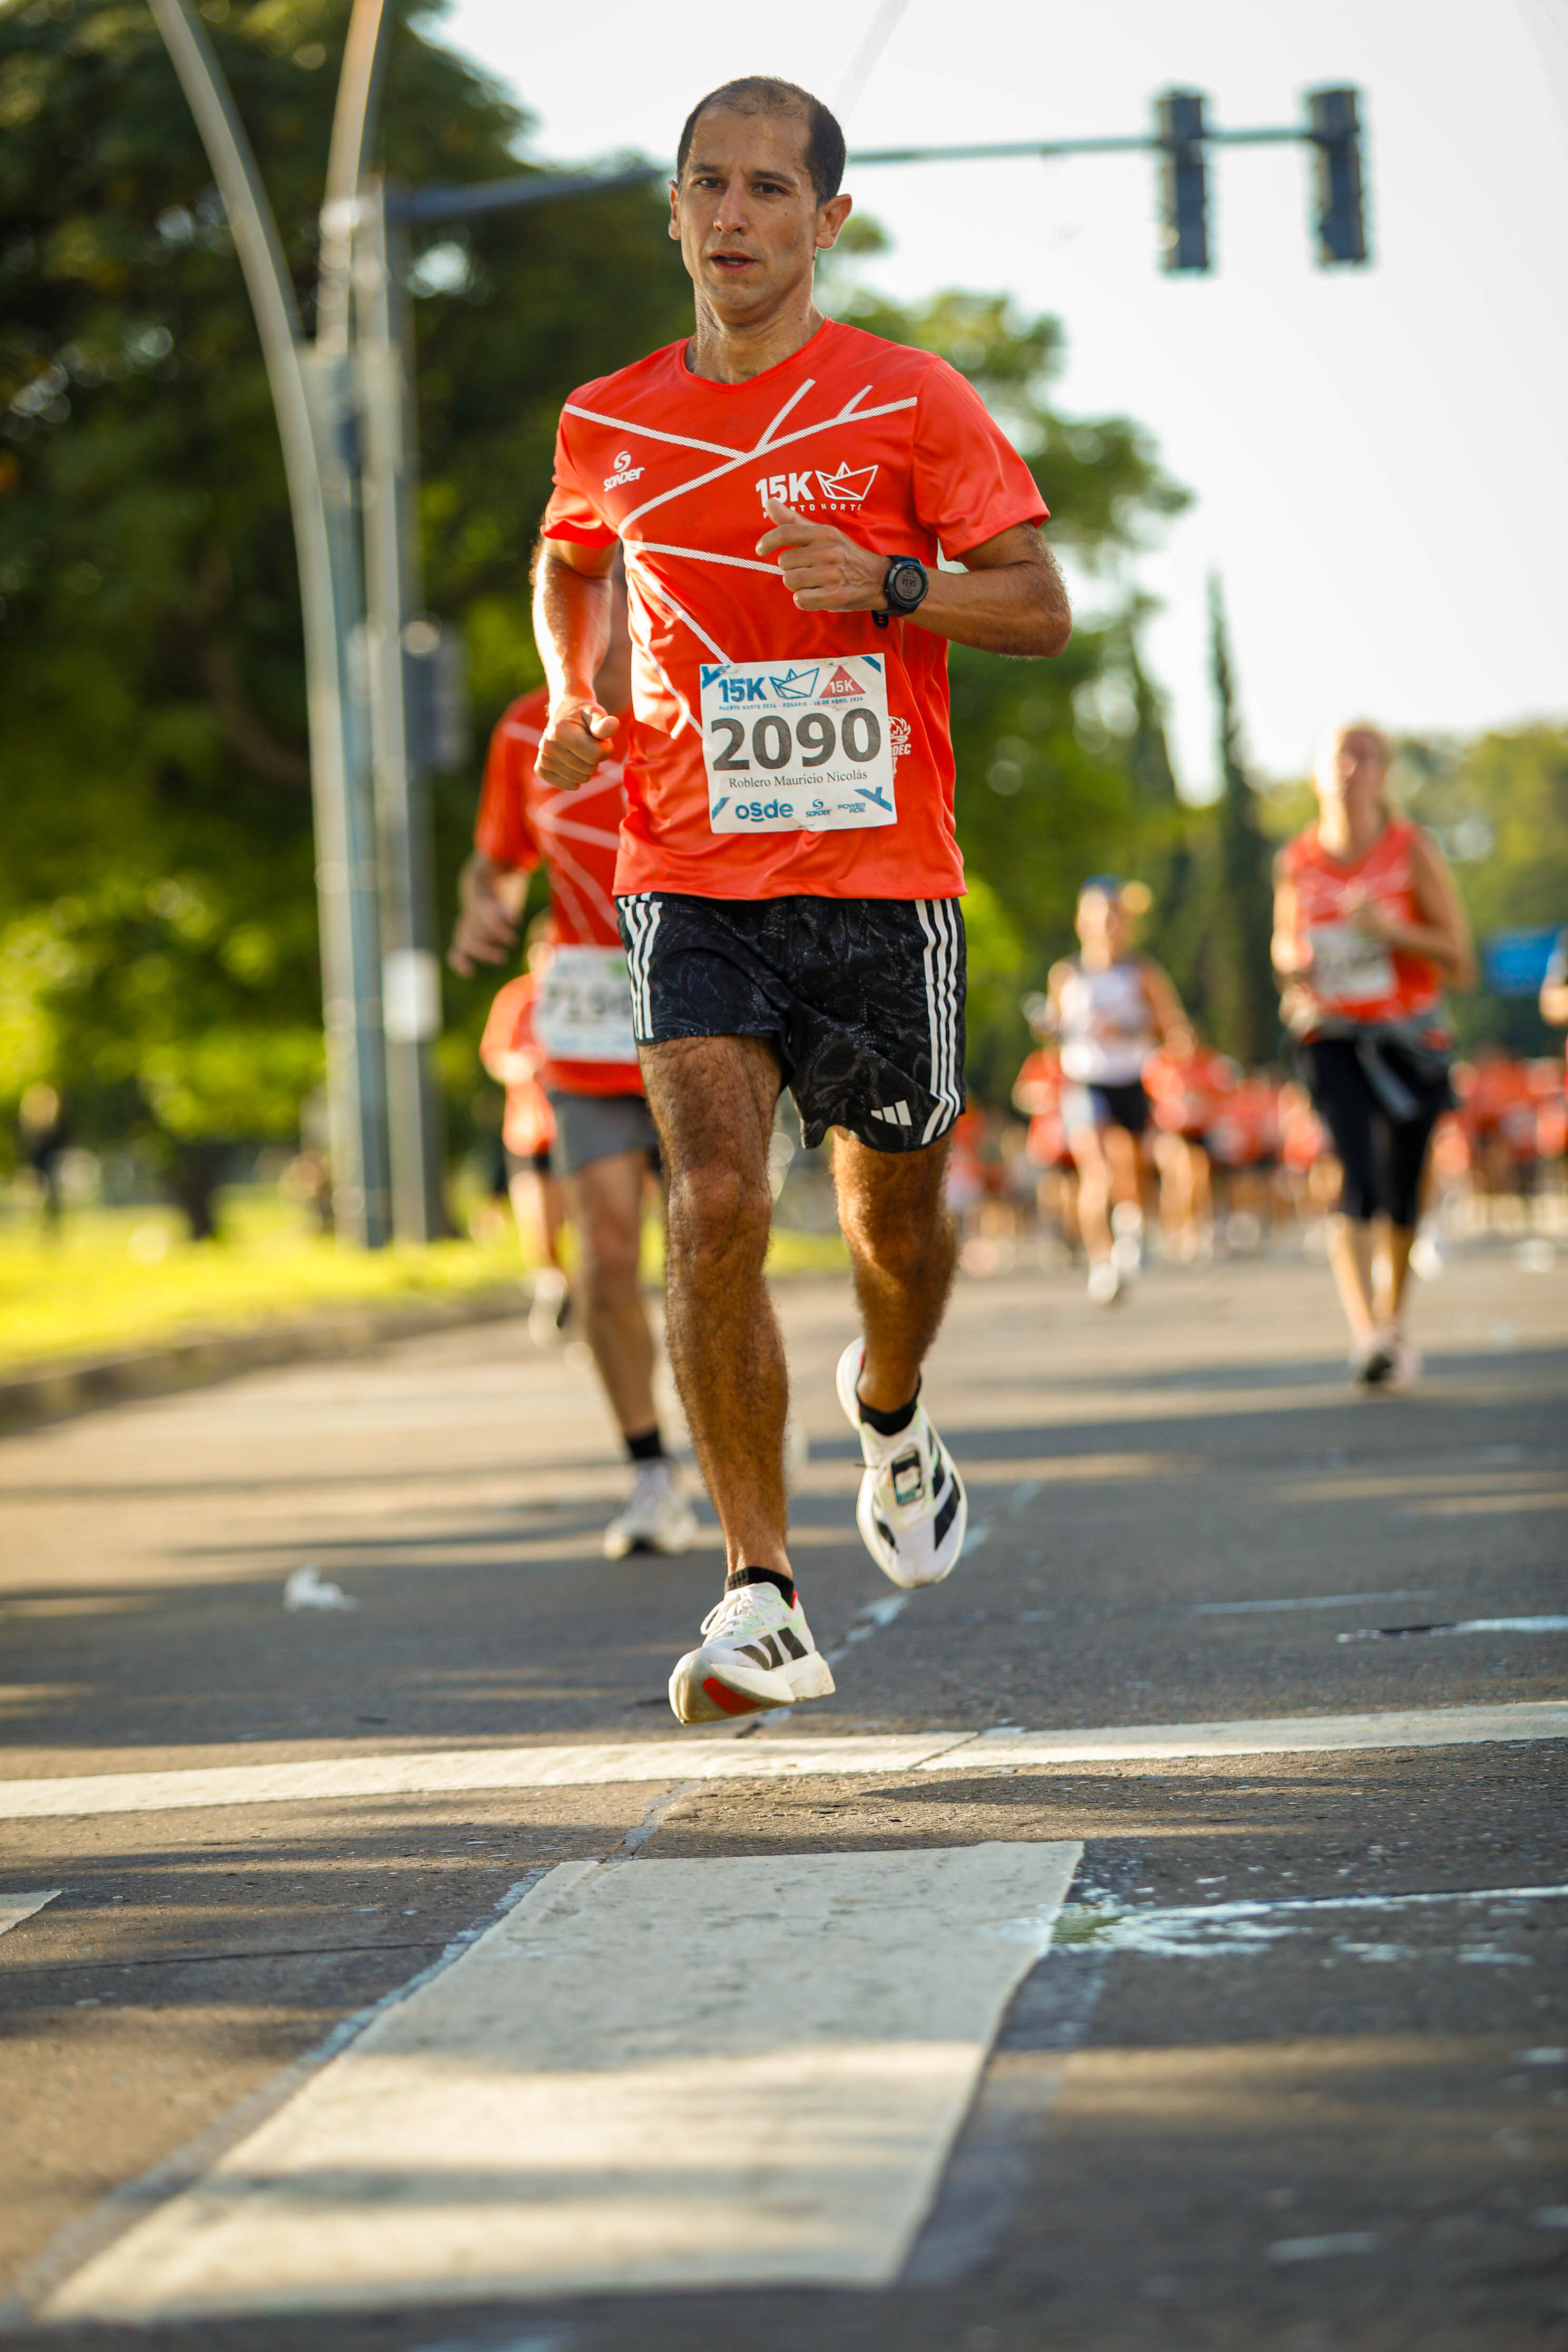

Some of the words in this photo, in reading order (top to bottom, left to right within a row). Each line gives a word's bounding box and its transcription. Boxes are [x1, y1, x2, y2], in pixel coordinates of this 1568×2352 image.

[755, 471, 815, 508] 15K
[763, 504, 816, 519] PRTO
[719, 677, 767, 702] 15K
[829, 679, 855, 693] 15K
[711, 708, 881, 771] 2090
[729, 777, 771, 788] Roblero
[774, 773, 823, 786] Mauricio
[826, 769, 868, 782] Nicolás
[735, 798, 794, 820] osde
